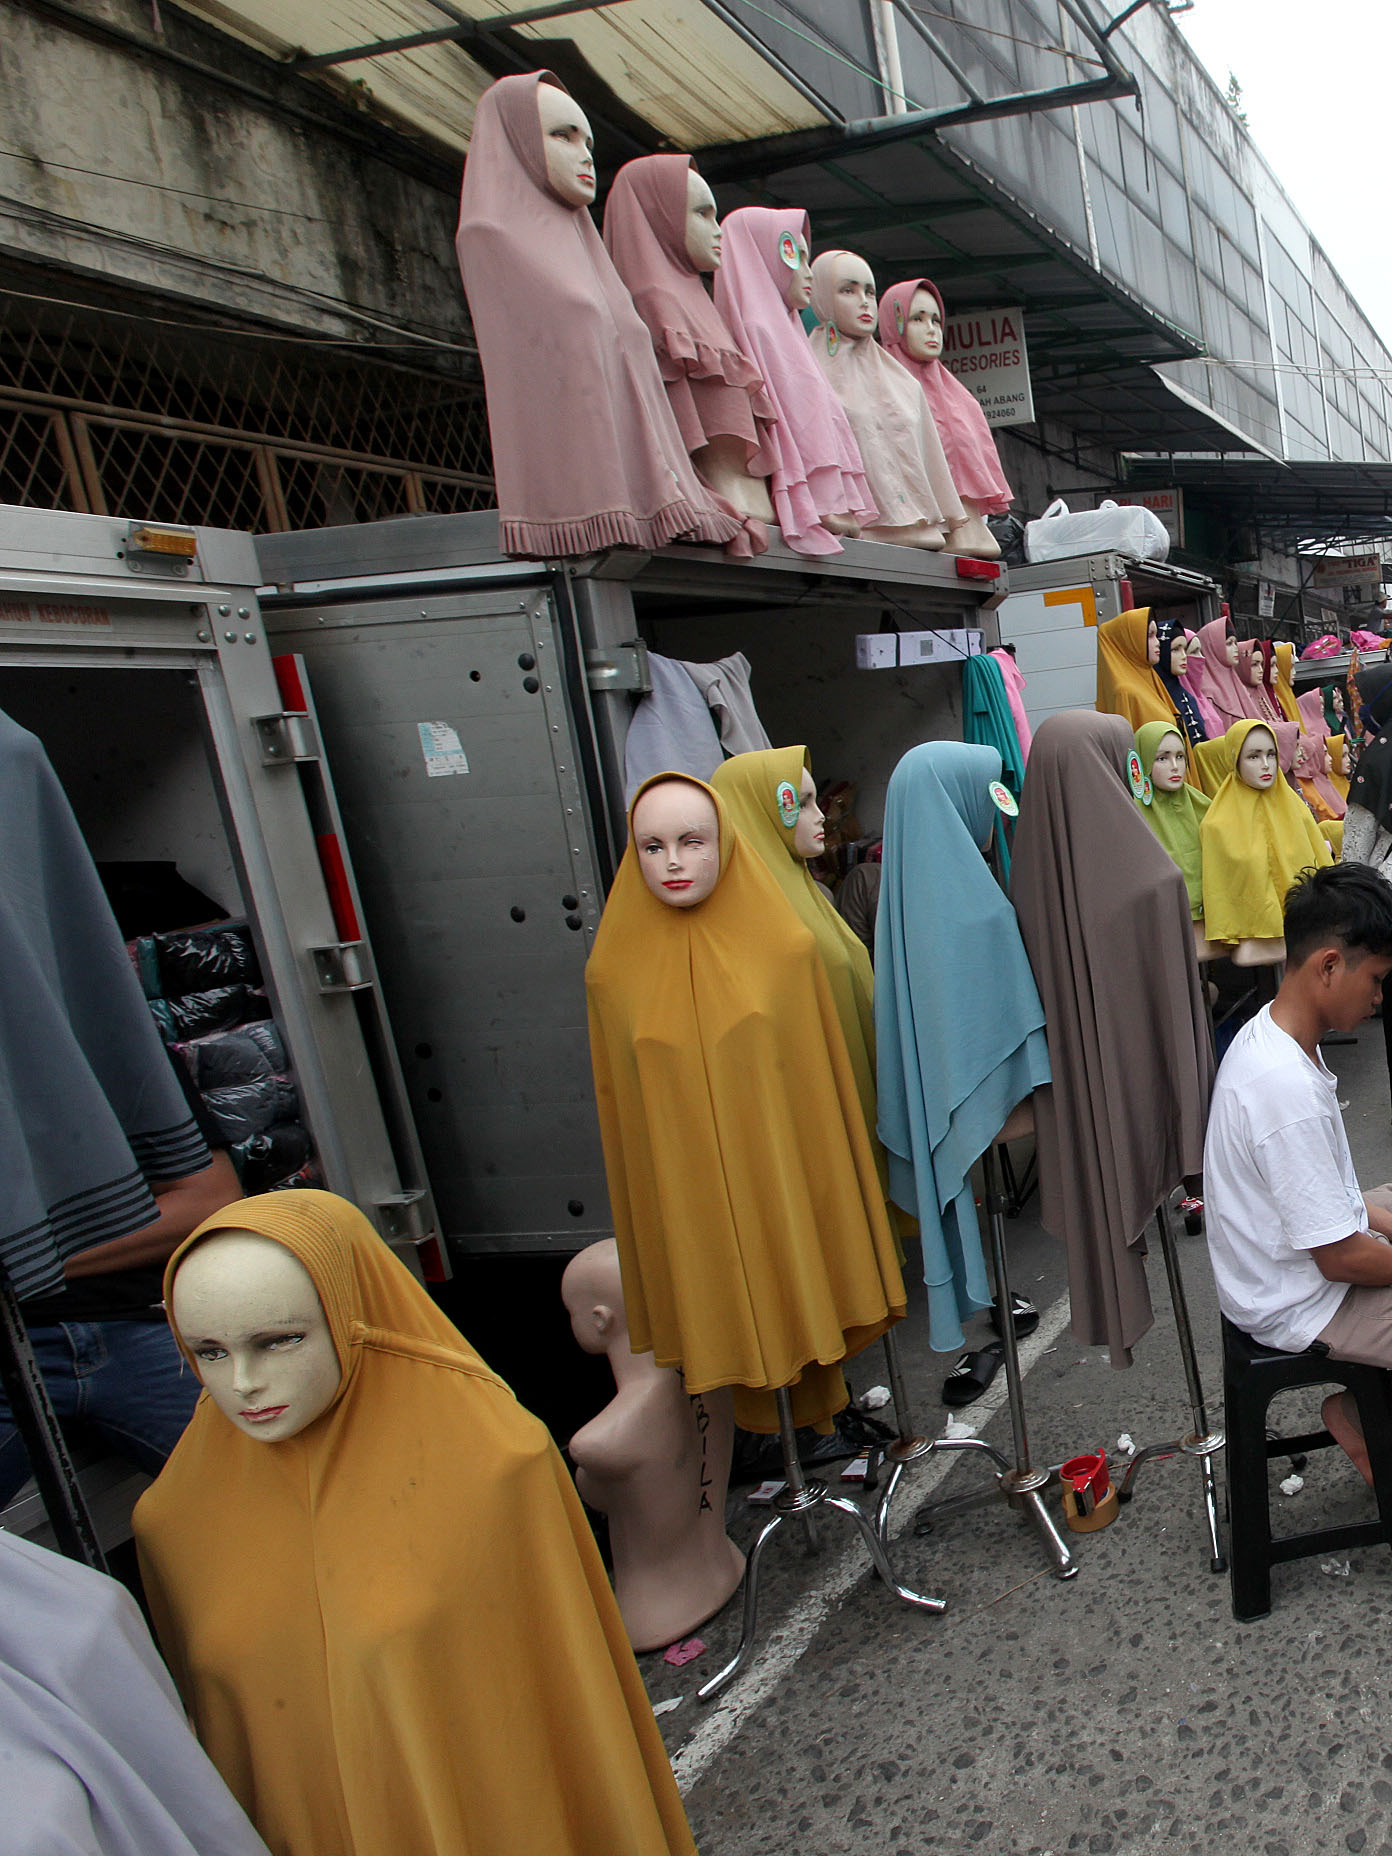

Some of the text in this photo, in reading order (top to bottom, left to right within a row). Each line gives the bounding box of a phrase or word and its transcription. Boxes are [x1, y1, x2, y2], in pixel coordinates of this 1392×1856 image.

[943, 316, 1018, 352] MULIA
[993, 393, 1025, 405] ABANG
[1144, 495, 1173, 509] HARI
[38, 604, 112, 626] KEBOCORAN
